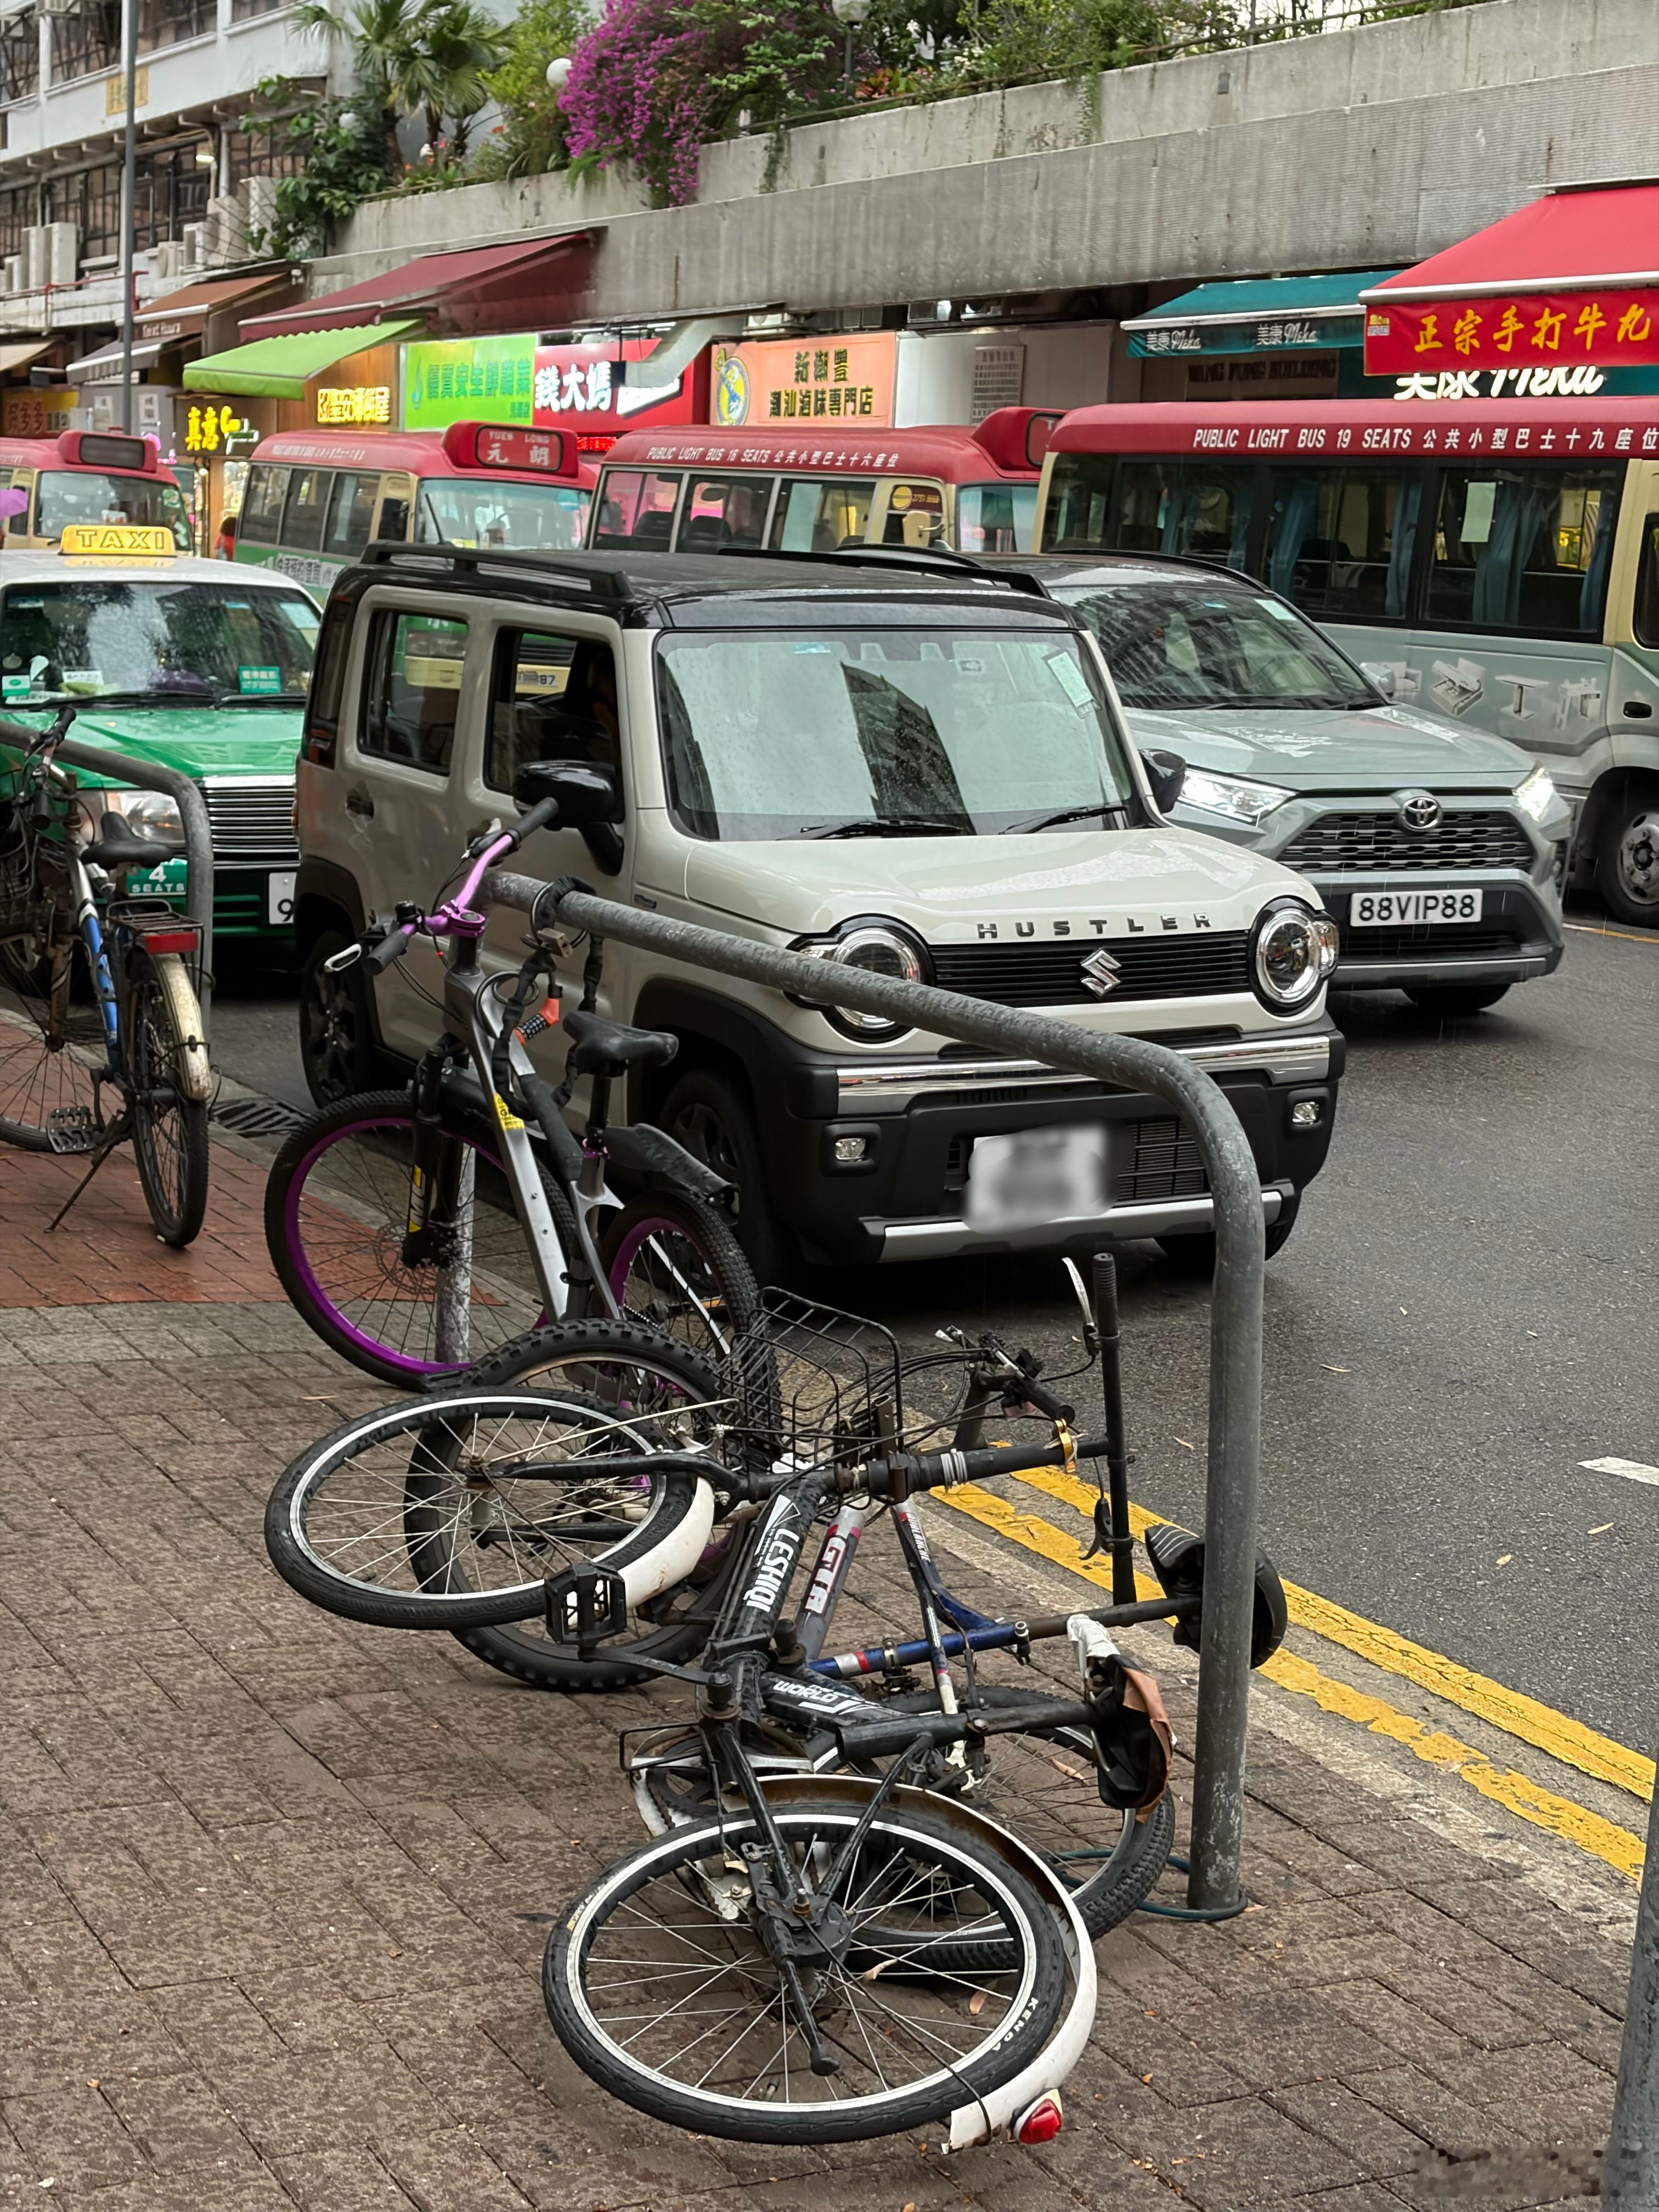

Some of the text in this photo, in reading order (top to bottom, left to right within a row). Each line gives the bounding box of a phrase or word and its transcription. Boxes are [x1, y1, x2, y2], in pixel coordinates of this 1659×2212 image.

[1414, 302, 1650, 355] 正宗手打牛丸
[534, 361, 612, 412] 錢大媽
[1193, 427, 1658, 450] PUBLIC LIGHT BUS 19 SEATS 公共小型巴士十九座位
[646, 447, 676, 460] PUBLIC
[678, 447, 704, 460] LIGHT
[705, 448, 725, 461] BUS
[727, 449, 740, 462] 16
[741, 449, 771, 463] SEATS
[76, 529, 165, 549] TAXI
[149, 865, 166, 882] 4
[132, 883, 185, 893] SEATS
[1358, 894, 1475, 922] 88VIP88
[977, 912, 1211, 939] HUSTLER
[743, 1528, 800, 1613] LESHIQI
[773, 1680, 839, 1702] WORLD
[991, 1997, 1039, 2052] KENDA
